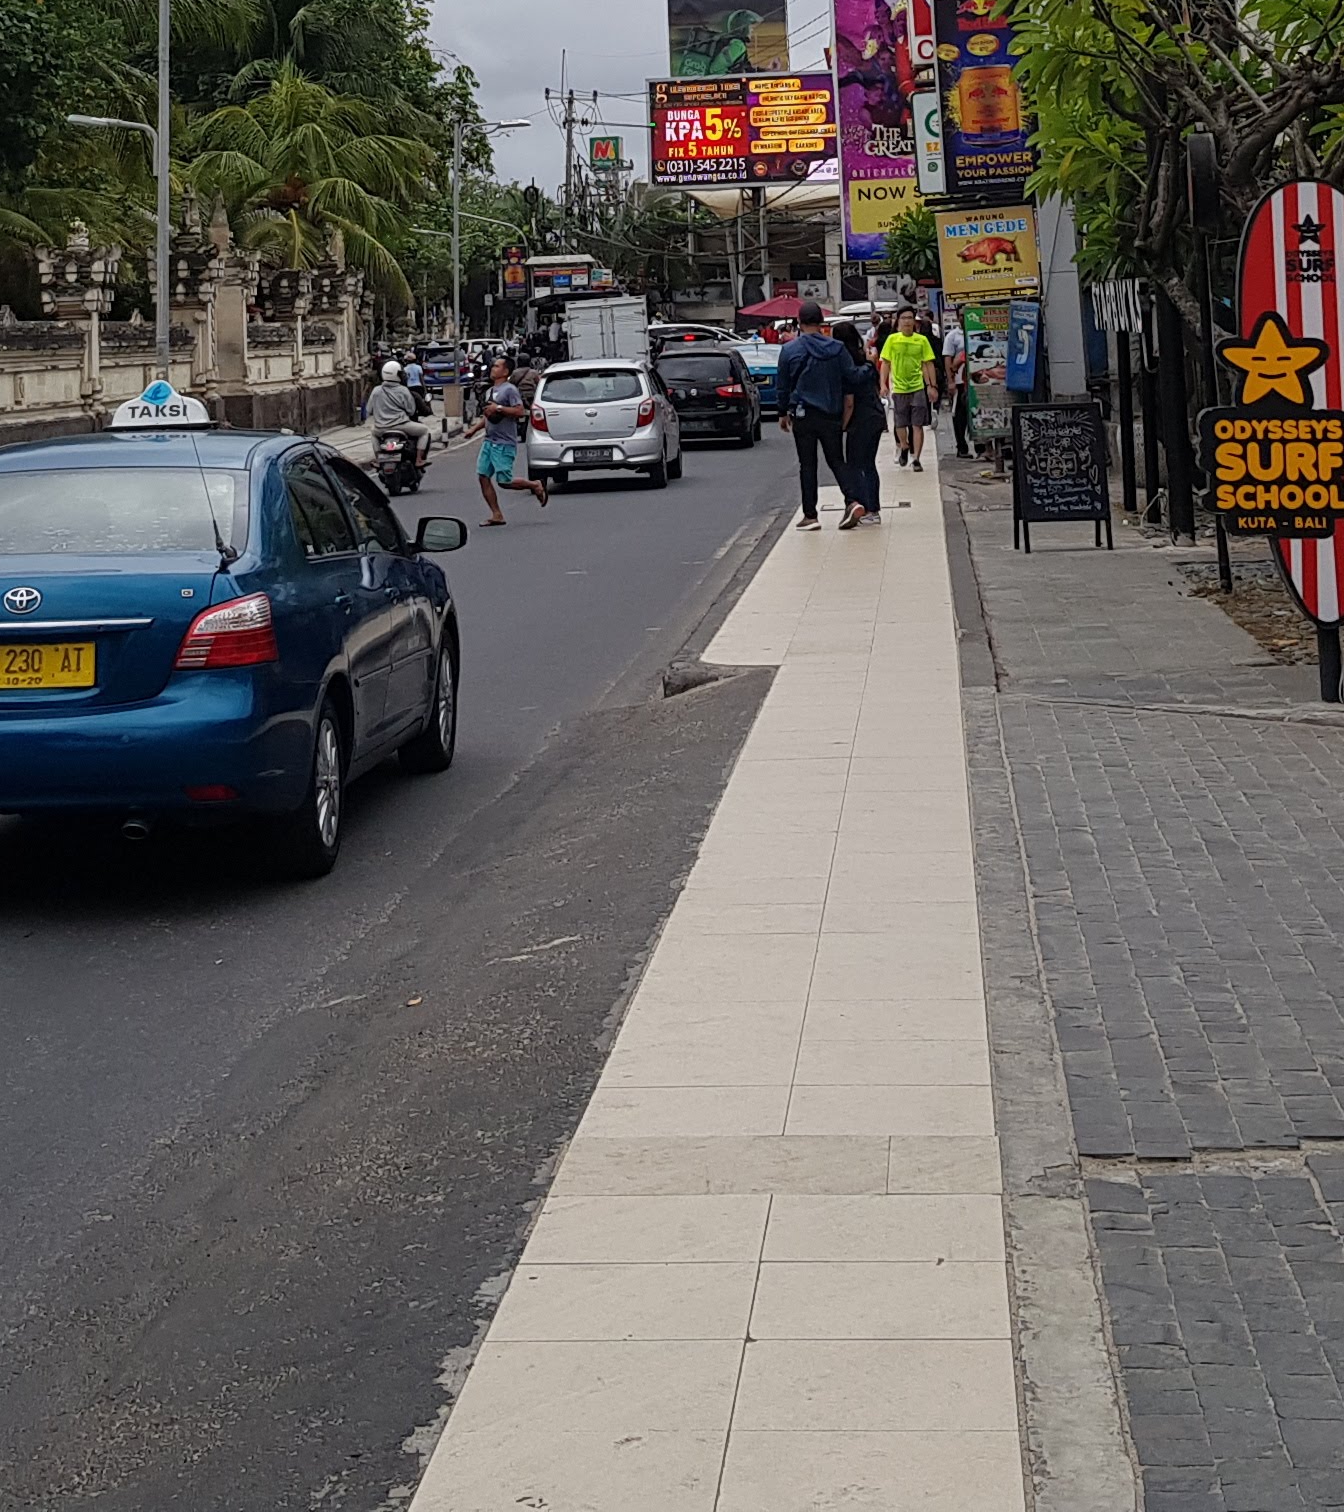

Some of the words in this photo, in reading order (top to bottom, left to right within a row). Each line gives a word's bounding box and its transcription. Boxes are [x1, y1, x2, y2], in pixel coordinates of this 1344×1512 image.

[667, 109, 701, 121] BUNGA
[665, 120, 704, 142] KPA
[871, 123, 902, 141] THE
[668, 147, 685, 158] FIX
[688, 141, 697, 157] 5
[701, 144, 734, 156] TAHUN
[864, 139, 915, 157] GREAT
[718, 157, 746, 171] 2215
[956, 151, 1033, 168] EMPOWER
[957, 167, 987, 179] YOUR
[988, 164, 1034, 177] PASSION
[857, 185, 906, 202] NOW
[965, 212, 1005, 223] WARUNG
[945, 222, 980, 238] MEN
[983, 218, 1028, 235] GEDE
[1285, 258, 1335, 273] SURF
[127, 404, 188, 419] TAKSI
[1214, 419, 1343, 440] ODYSSEYS
[1215, 441, 1344, 482] SURF
[1237, 516, 1277, 529] KUTA
[1294, 516, 1327, 529] BALI
[4, 648, 43, 674] 230
[60, 647, 85, 673] AT
